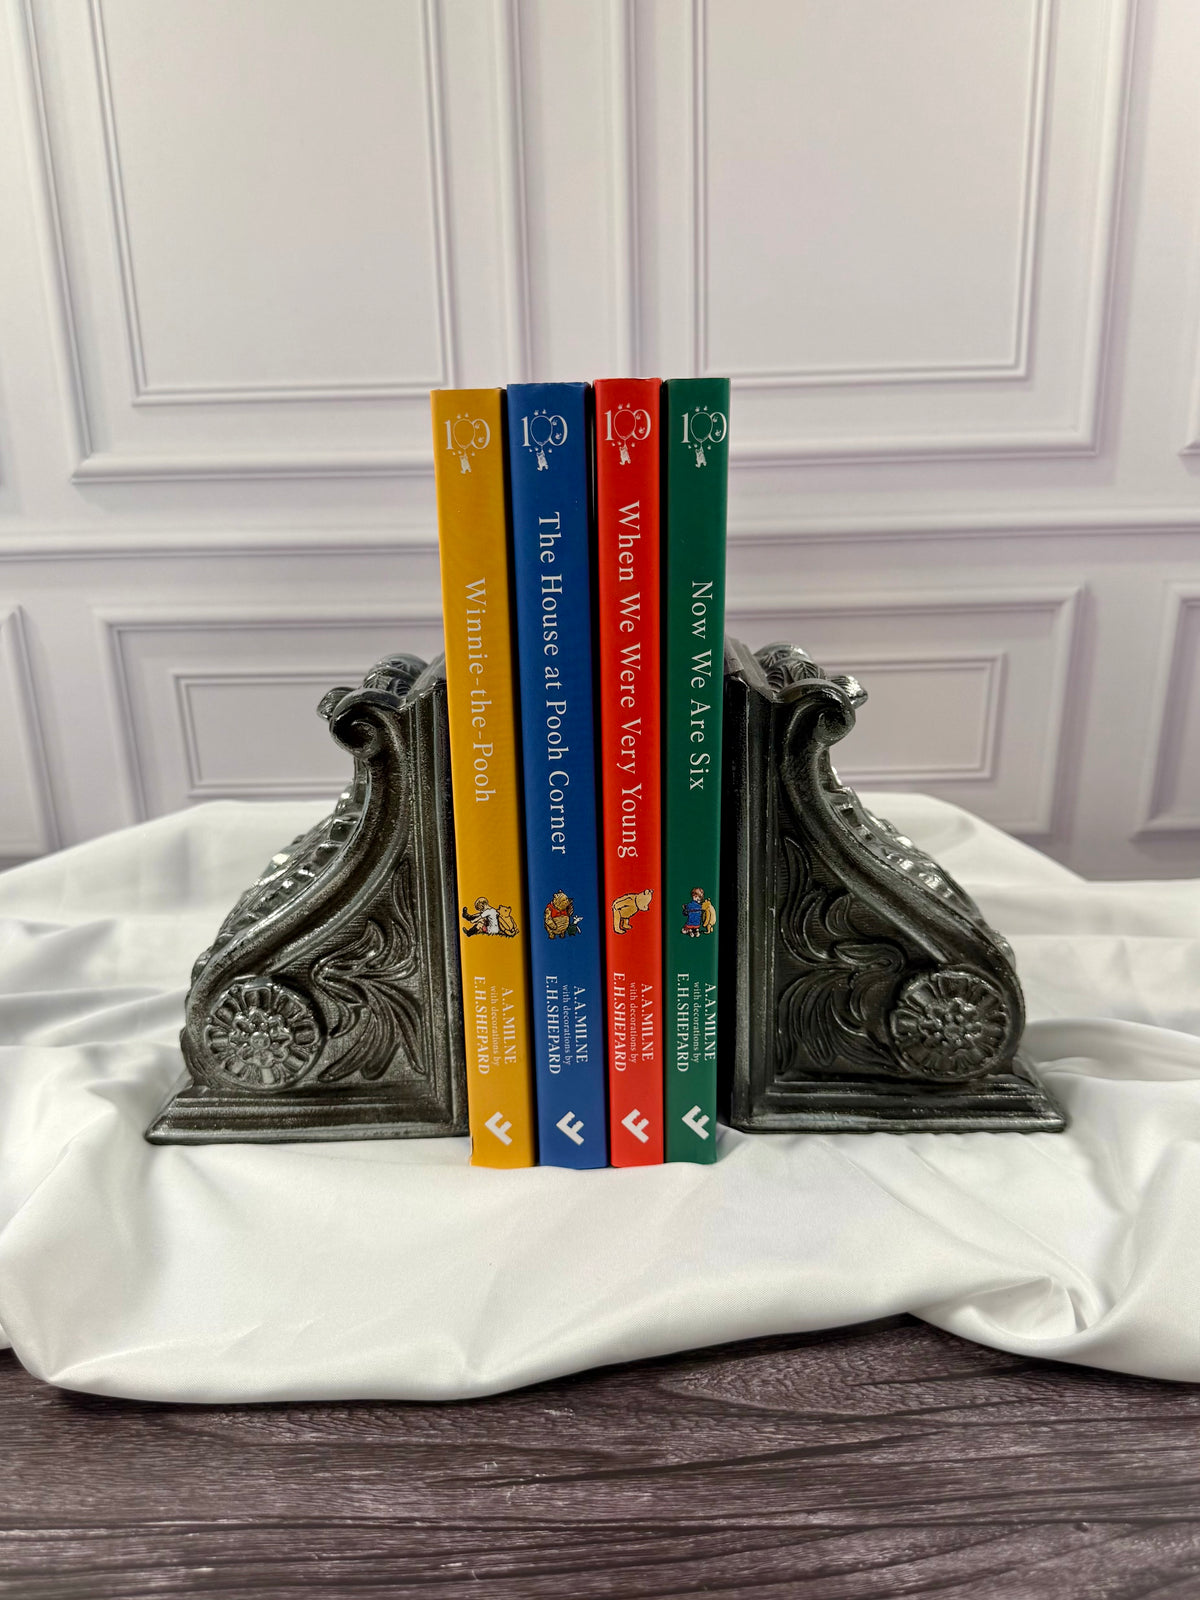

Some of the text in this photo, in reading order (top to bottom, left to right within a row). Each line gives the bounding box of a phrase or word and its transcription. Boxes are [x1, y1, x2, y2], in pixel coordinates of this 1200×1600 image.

[465, 578, 496, 803] Winnie-the-Pooh
[539, 512, 570, 854] The House at Pooh Corner
[617, 500, 643, 858] When We Were Very Young
[690, 581, 713, 790] Now We Are Six
[474, 976, 490, 1075] E.H.SHEPARD
[494, 1055, 500, 1066] by
[501, 987, 516, 1064] A.A.MILNE
[546, 975, 560, 1074] E.H.SHEPARD
[566, 1055, 571, 1065] by
[574, 985, 588, 1063] A.A.MILNE
[613, 972, 626, 1072] E.H.SHEPARD
[630, 1053, 636, 1063] by
[642, 983, 654, 1060] A.A.MILNE
[677, 973, 688, 1072] E.H.SHEPARD
[692, 1052, 699, 1062] by
[704, 983, 716, 1060] A.A.MILNE
